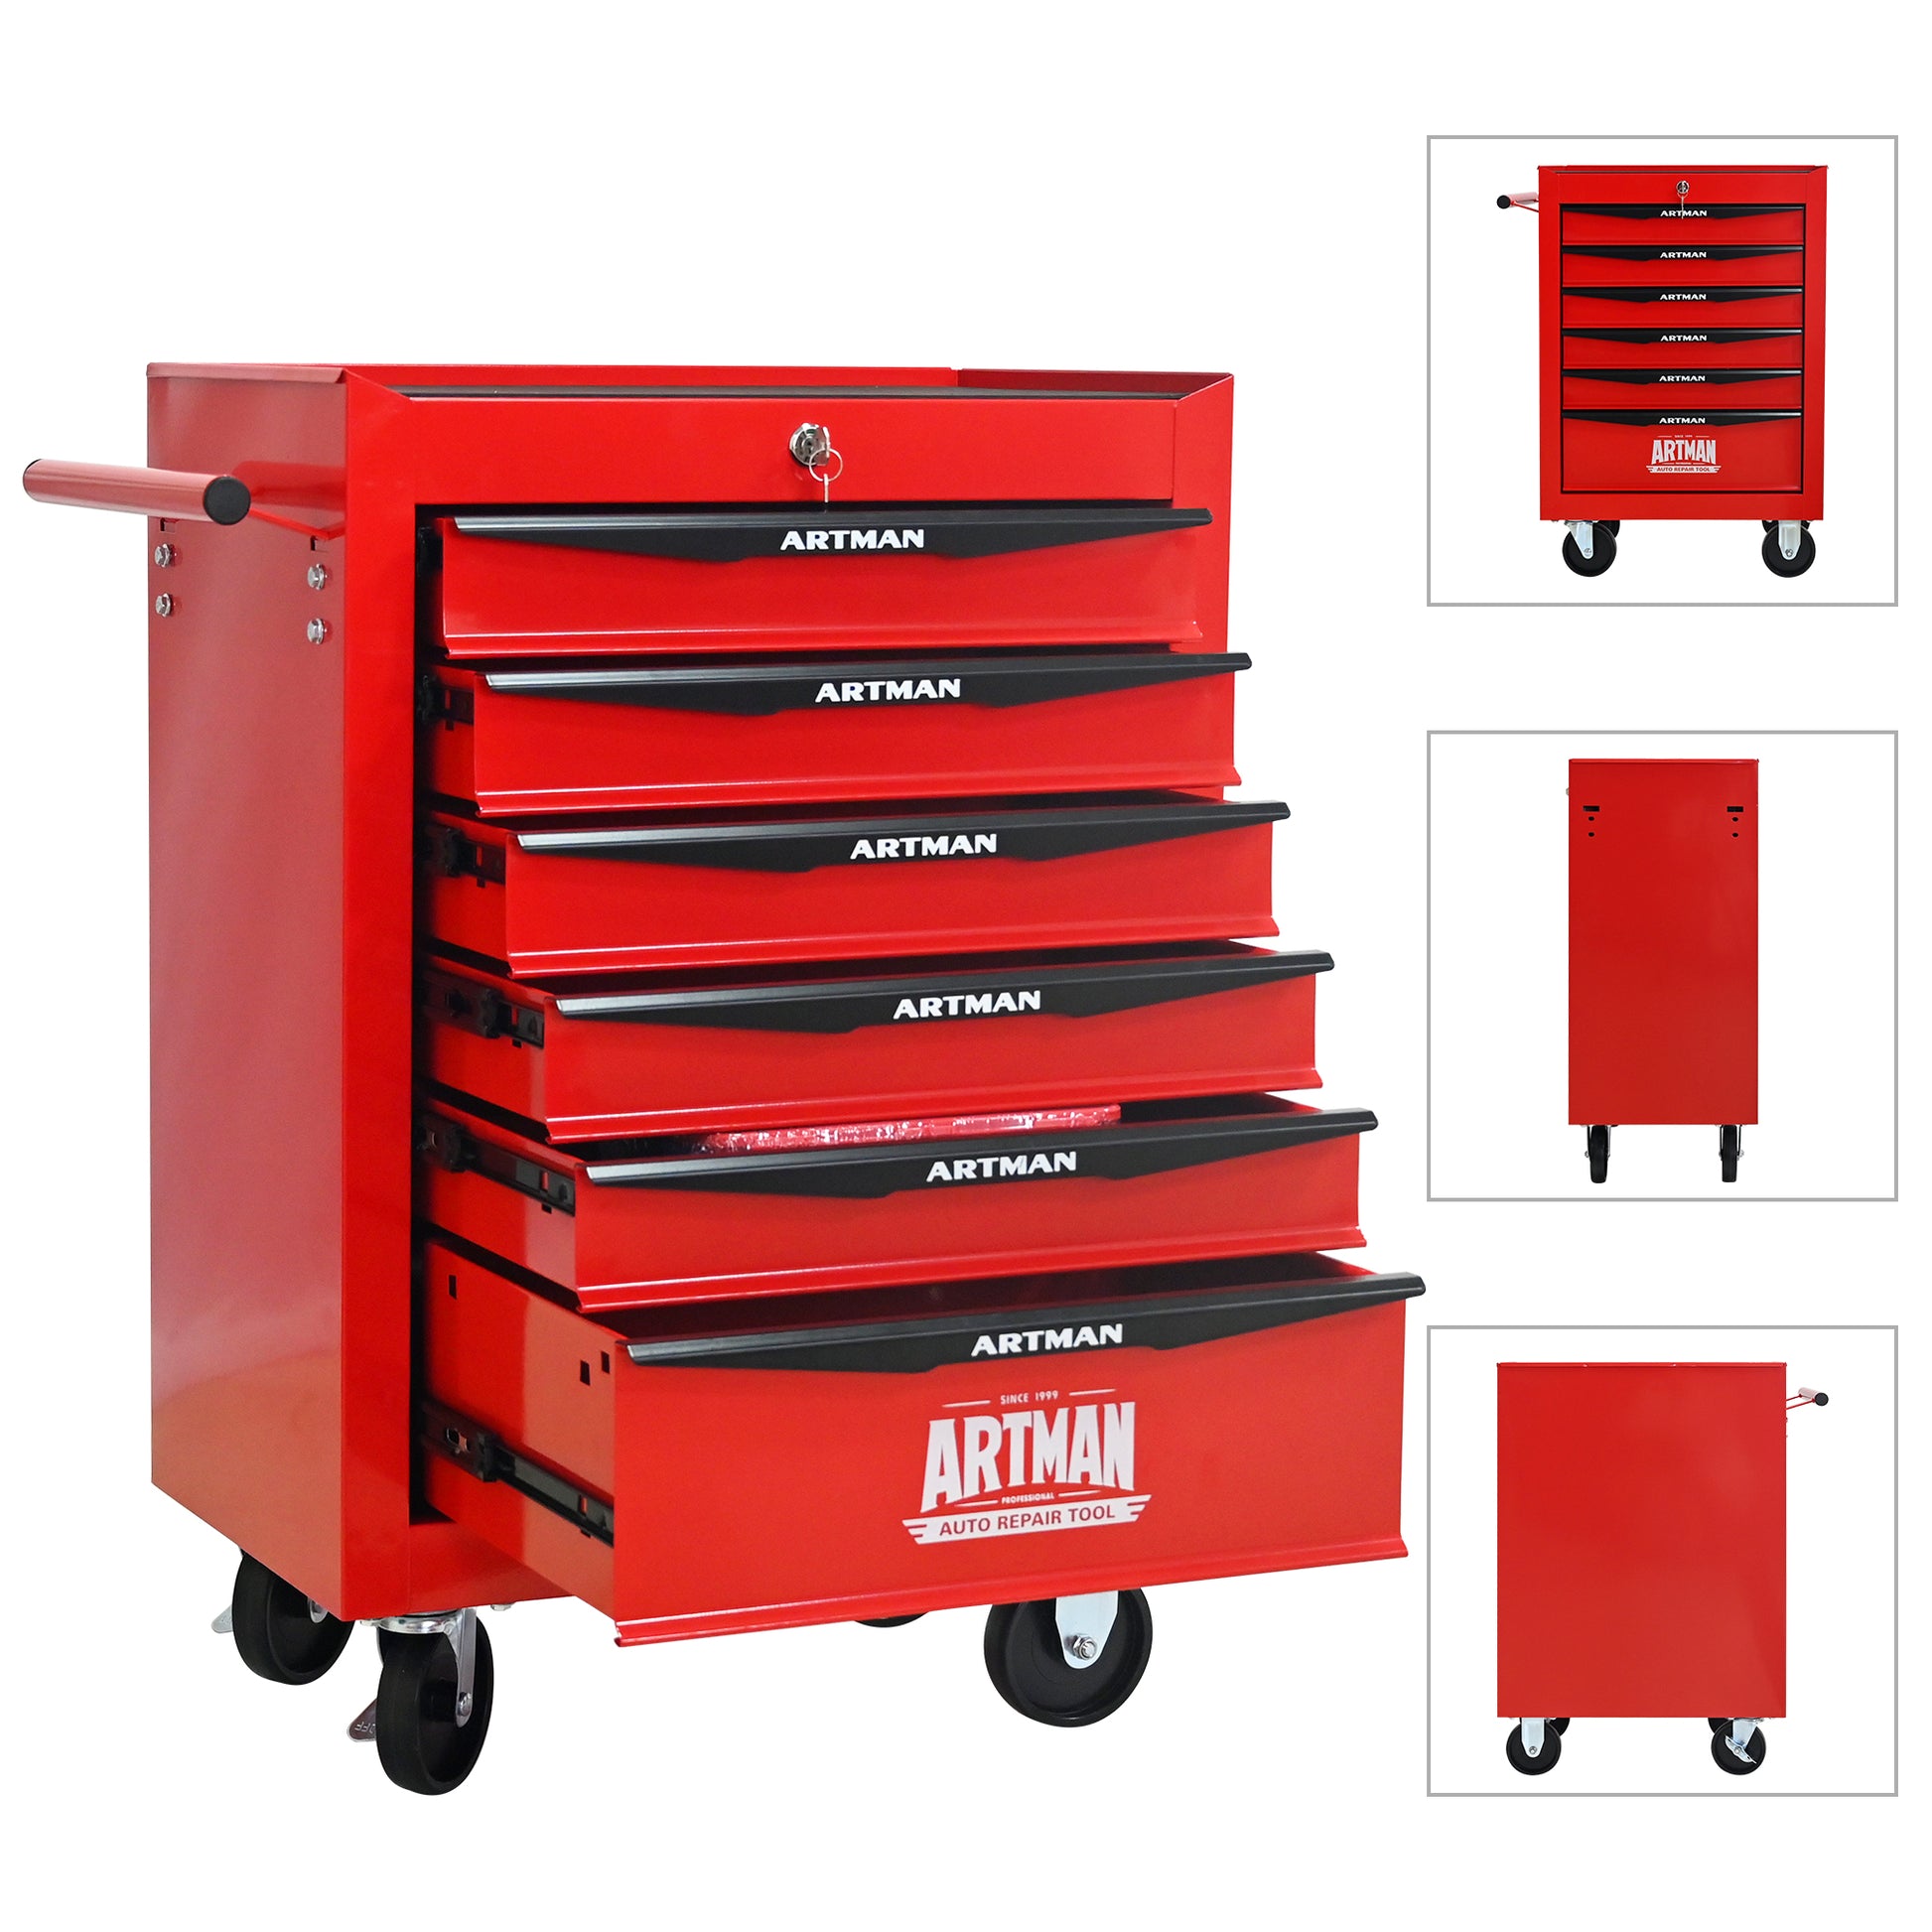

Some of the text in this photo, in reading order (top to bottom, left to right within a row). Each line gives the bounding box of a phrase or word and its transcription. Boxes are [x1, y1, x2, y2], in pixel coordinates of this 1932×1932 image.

[1651, 440, 1717, 465] ARTMAN
[779, 528, 924, 551] ARTMAN
[814, 678, 961, 703] ARTMAN
[850, 833, 998, 860] ARTMAN
[893, 990, 1041, 1020] ARTMAN
[925, 1151, 1077, 1182] ARTMAN
[970, 1322, 1123, 1357] ARTMAN
[1000, 1390, 1059, 1405] SINCE 1999
[920, 1401, 1136, 1513] ARTMAN
[1001, 1492, 1055, 1504] PROFESSIONAL
[939, 1504, 1116, 1536] AUTO REPAIR TOOL
